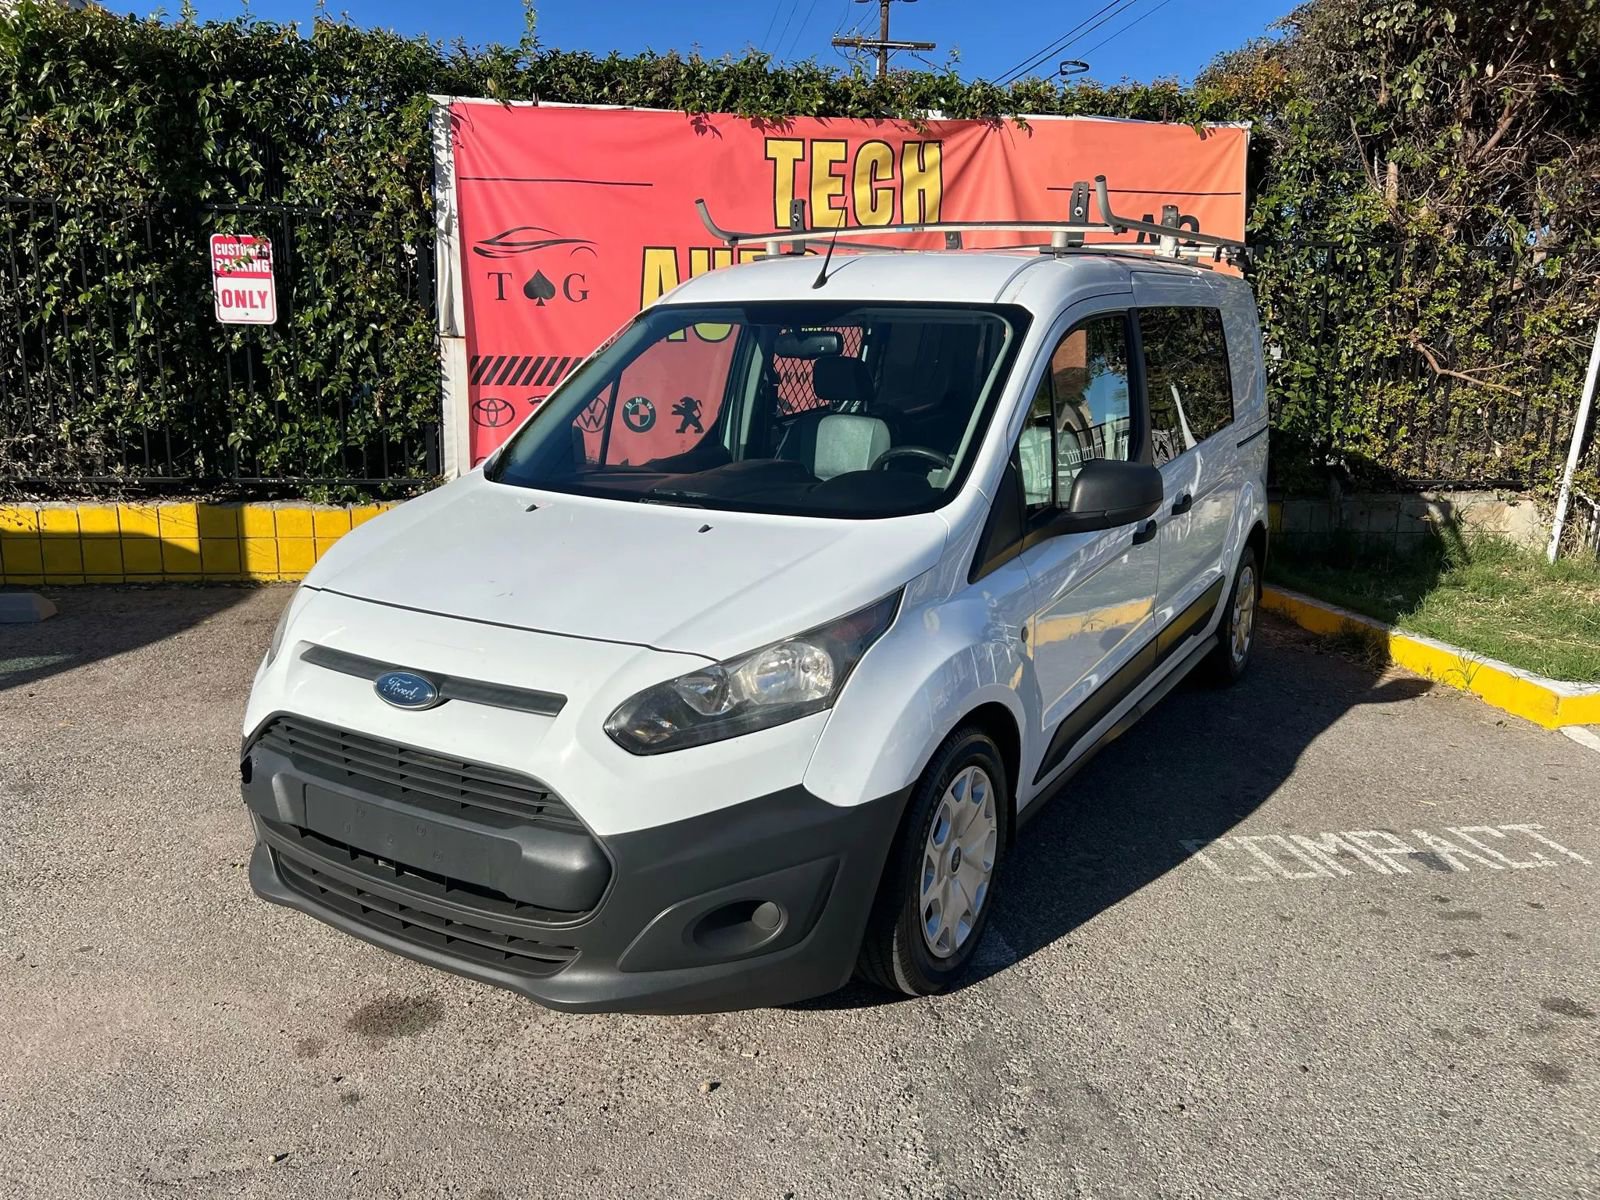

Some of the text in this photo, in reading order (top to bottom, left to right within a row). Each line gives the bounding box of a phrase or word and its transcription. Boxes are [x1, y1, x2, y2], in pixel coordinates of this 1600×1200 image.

[765, 138, 943, 228] TECH
[221, 288, 268, 309] ONLY
[1179, 822, 1592, 883] COMPACT
